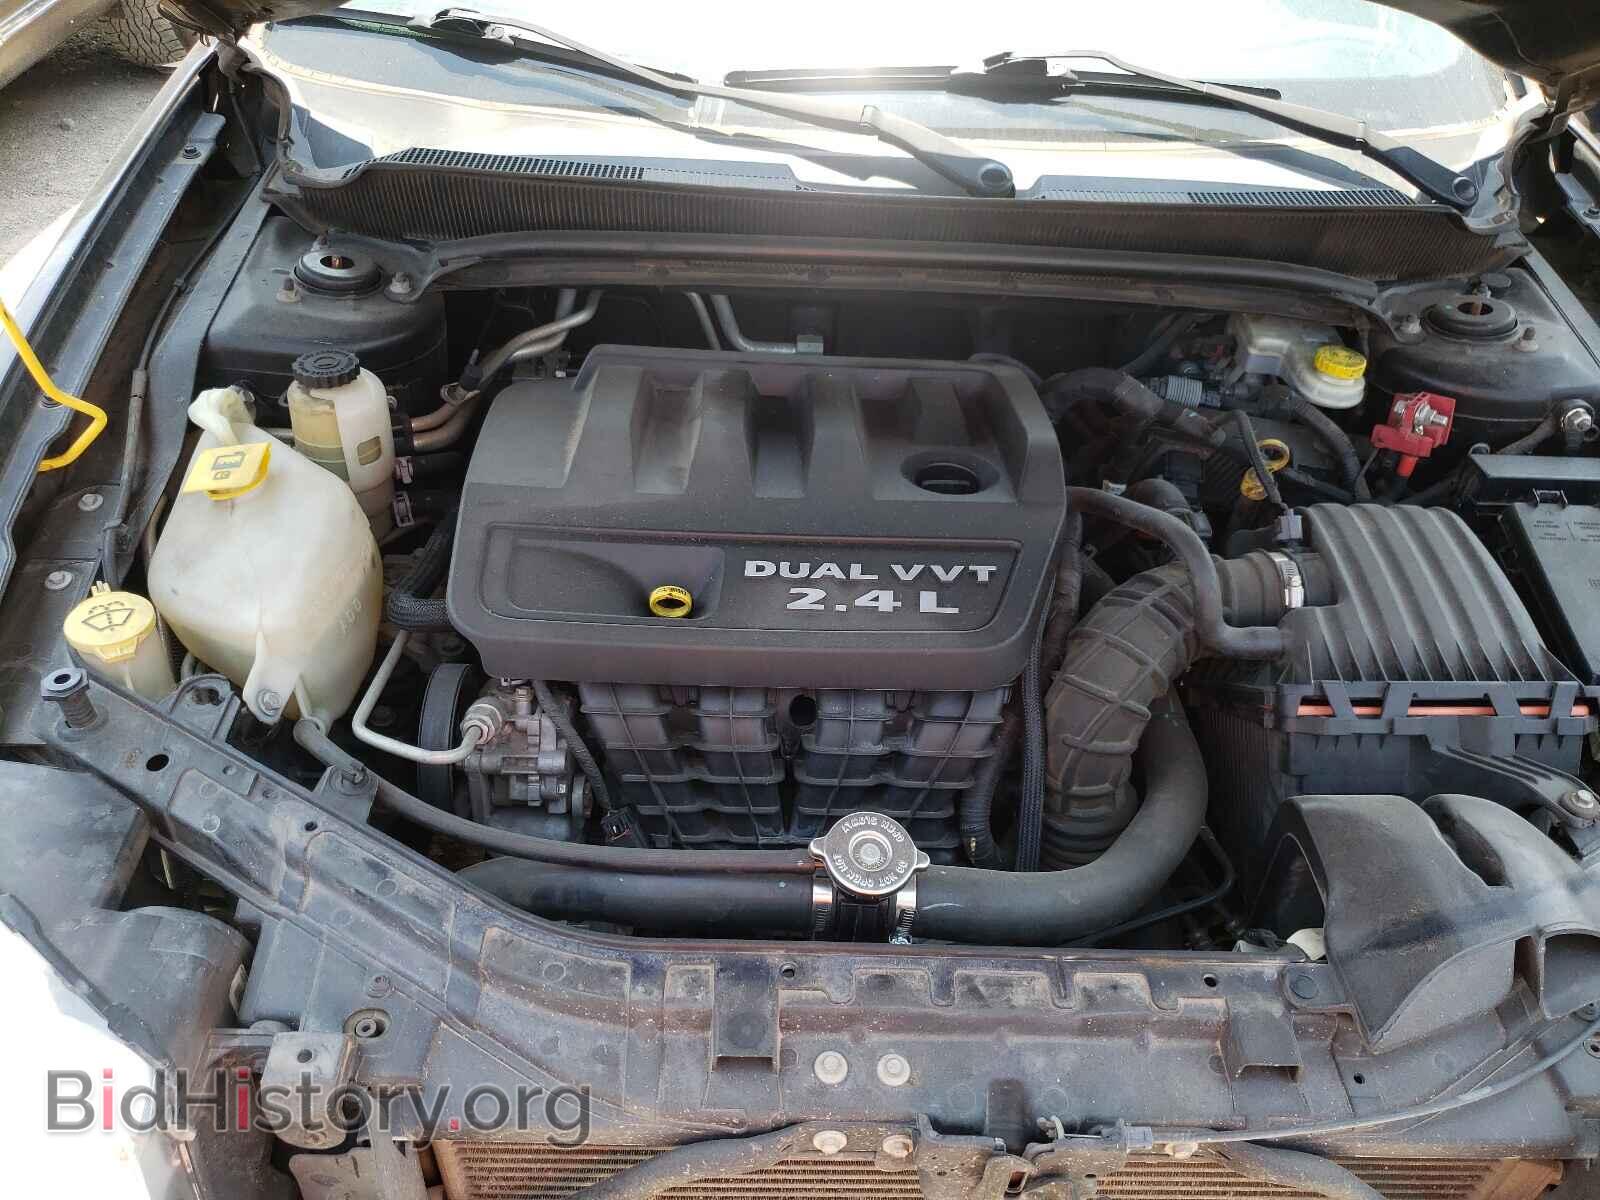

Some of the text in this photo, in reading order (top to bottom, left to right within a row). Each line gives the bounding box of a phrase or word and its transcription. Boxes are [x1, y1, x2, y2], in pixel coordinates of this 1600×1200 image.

[744, 560, 998, 582] DUAL VVT
[879, 871, 898, 887] NOT
